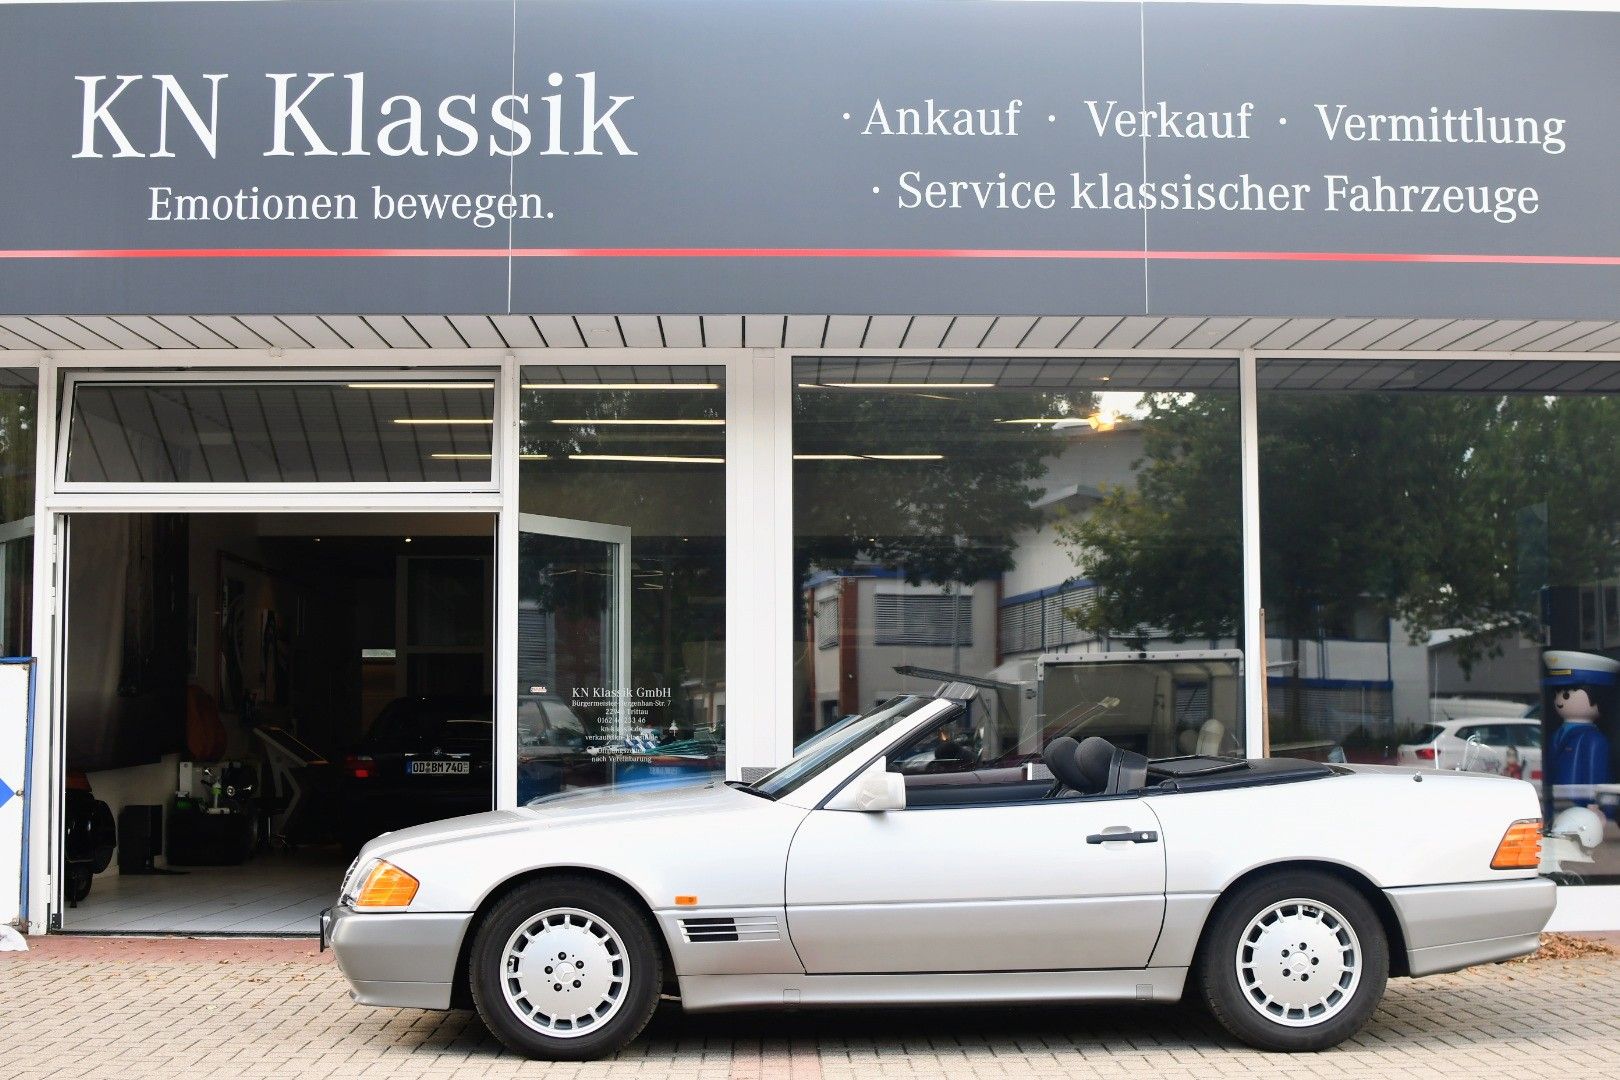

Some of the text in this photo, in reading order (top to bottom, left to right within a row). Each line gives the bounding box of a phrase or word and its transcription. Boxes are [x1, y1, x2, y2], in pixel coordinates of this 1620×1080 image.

[72, 71, 639, 159] KN Klassik
[861, 98, 1567, 155] Ankauf Verkauf Vermittlung
[148, 185, 554, 228] Emotionen bewegen.
[897, 172, 1539, 224] Service klassischer Fahrzeuge
[572, 687, 672, 698] KN Klassik GmbH
[445, 762, 463, 773] 740
